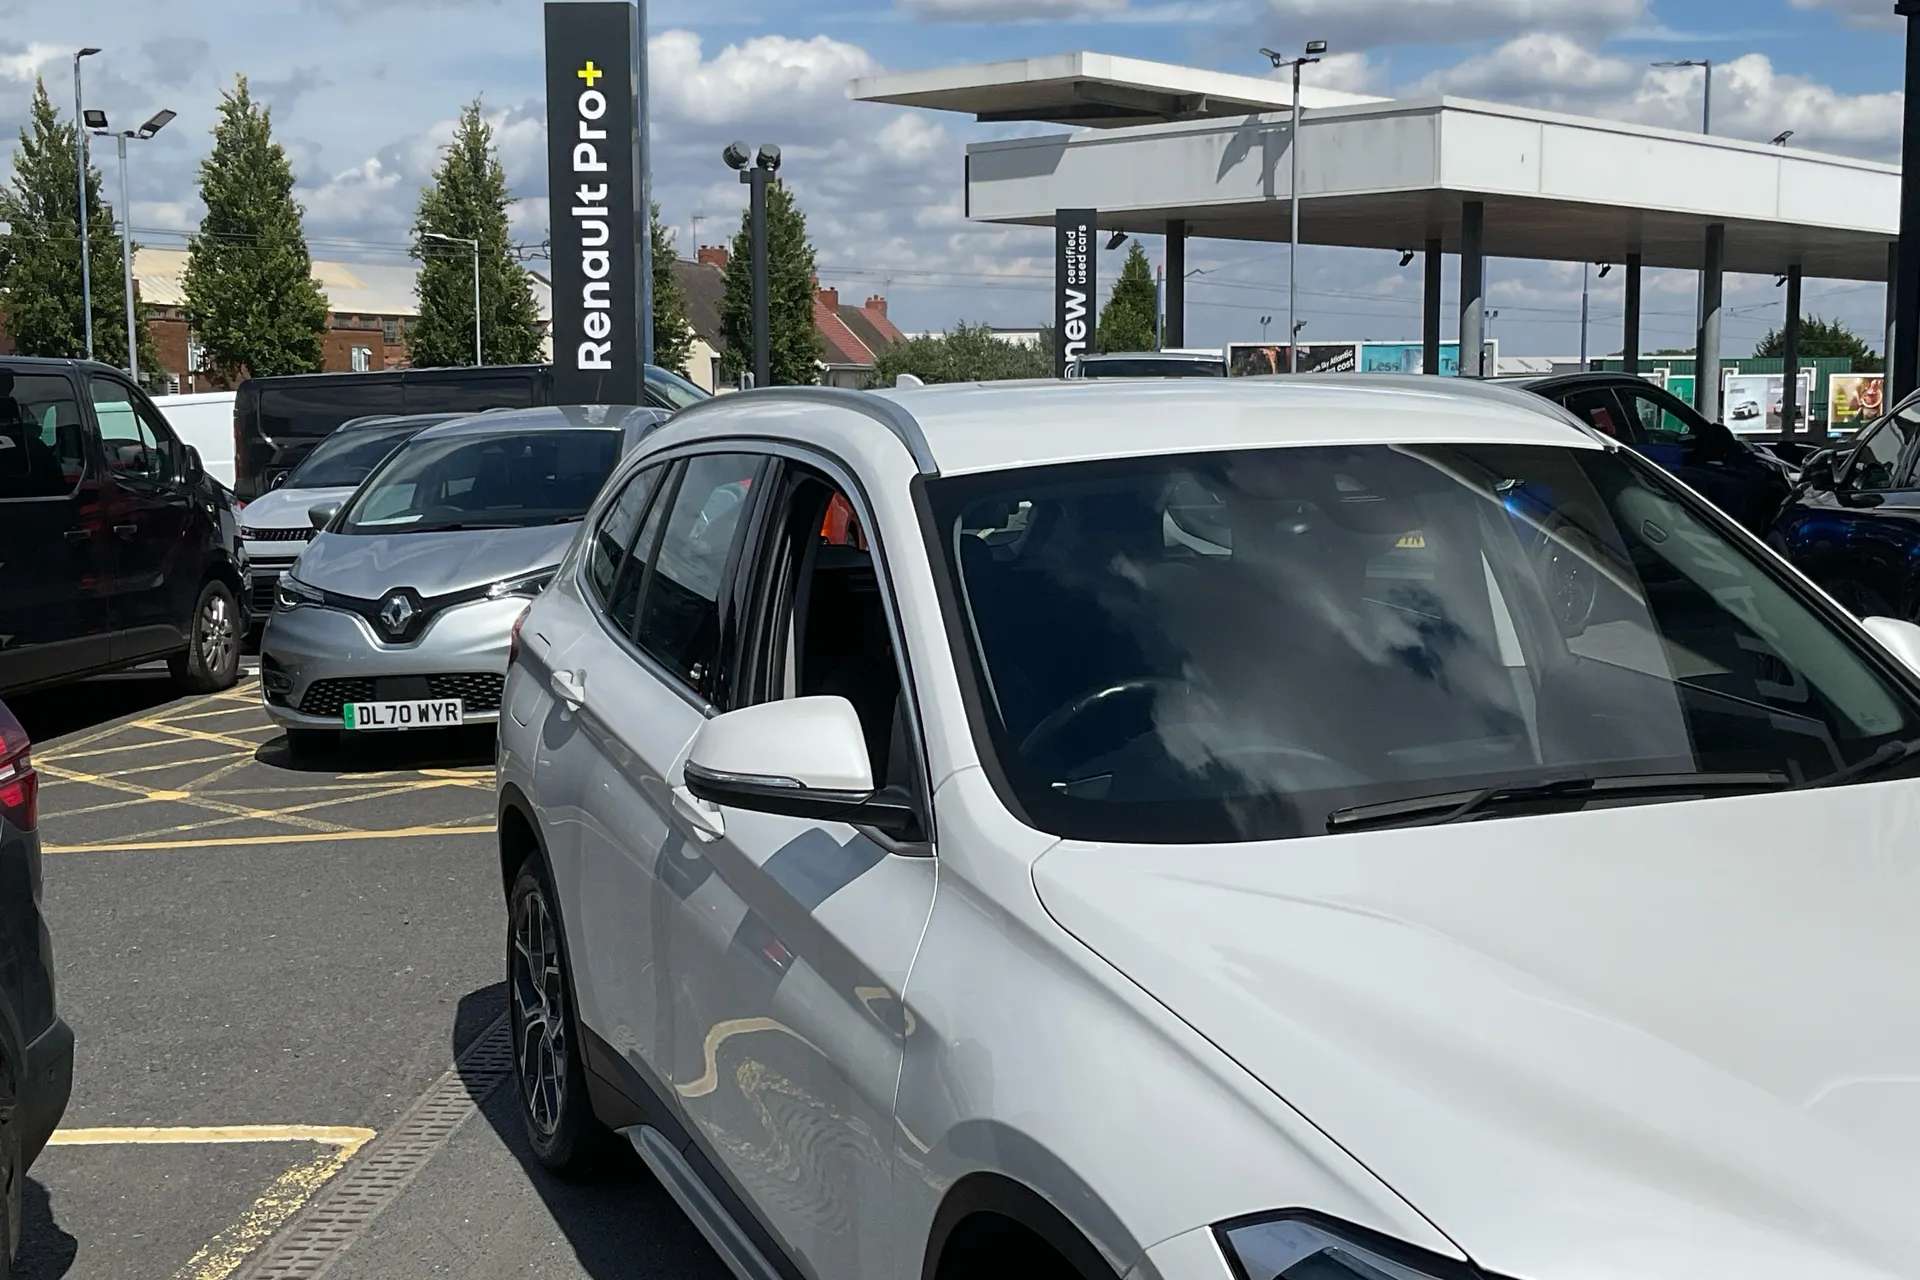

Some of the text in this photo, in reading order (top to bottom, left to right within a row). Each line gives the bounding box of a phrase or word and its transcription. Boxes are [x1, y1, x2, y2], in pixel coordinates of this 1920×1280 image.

[571, 61, 612, 370] Renault Pro+
[1065, 231, 1076, 284] certified
[1077, 224, 1087, 284] used cars
[1329, 349, 1353, 366] Atlantic
[1336, 357, 1354, 371] cost
[1367, 358, 1400, 371] Less
[358, 702, 458, 725] DL70 WYR
